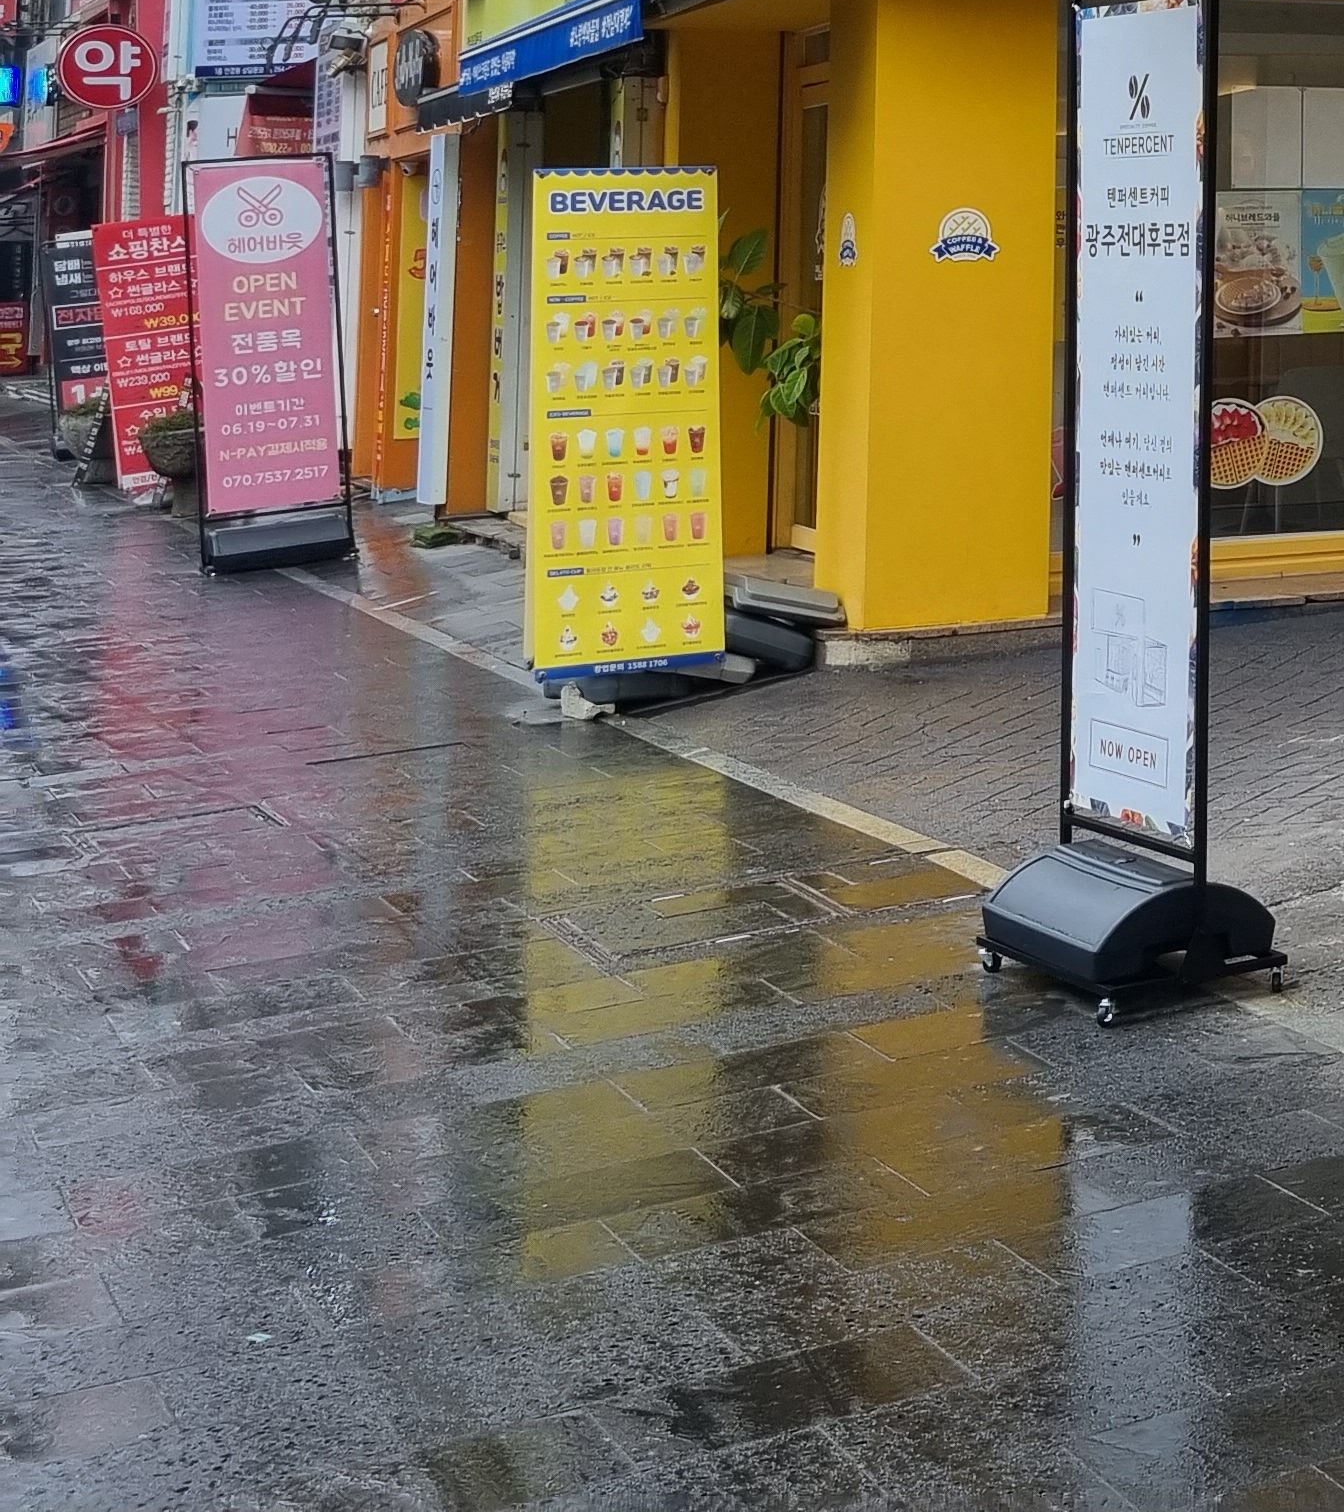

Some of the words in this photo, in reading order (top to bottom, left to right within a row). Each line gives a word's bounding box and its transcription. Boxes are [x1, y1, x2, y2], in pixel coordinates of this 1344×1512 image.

[74, 39, 145, 100] 약
[1103, 134, 1174, 155] TENPERCENT
[550, 189, 704, 213] BEVERAGE
[1107, 185, 1170, 209] 텐퍼센트커피
[122, 229, 134, 239] 더
[138, 225, 172, 238] 특별한
[226, 233, 304, 255] 헤어바웃
[1085, 221, 1190, 258] 광주전대후문점
[108, 235, 187, 261] 쇼핑찬스
[948, 245, 981, 253] WAFFLE
[109, 269, 150, 283] 하우스
[232, 271, 298, 295] OPEN
[127, 280, 182, 297] 썬글라스
[224, 297, 307, 322] EVENT
[231, 329, 303, 355] 전품목
[135, 349, 191, 365] 썬글라스
[213, 358, 324, 388] 30%할인
[235, 397, 306, 417] 이벤트기간
[221, 414, 321, 437] 06.19~07.31
[223, 465, 330, 489] 070.7537.2517
[1100, 458, 1122, 477] 맛있는
[1100, 738, 1123, 760] NOW
[1128, 746, 1157, 770] OPEN
